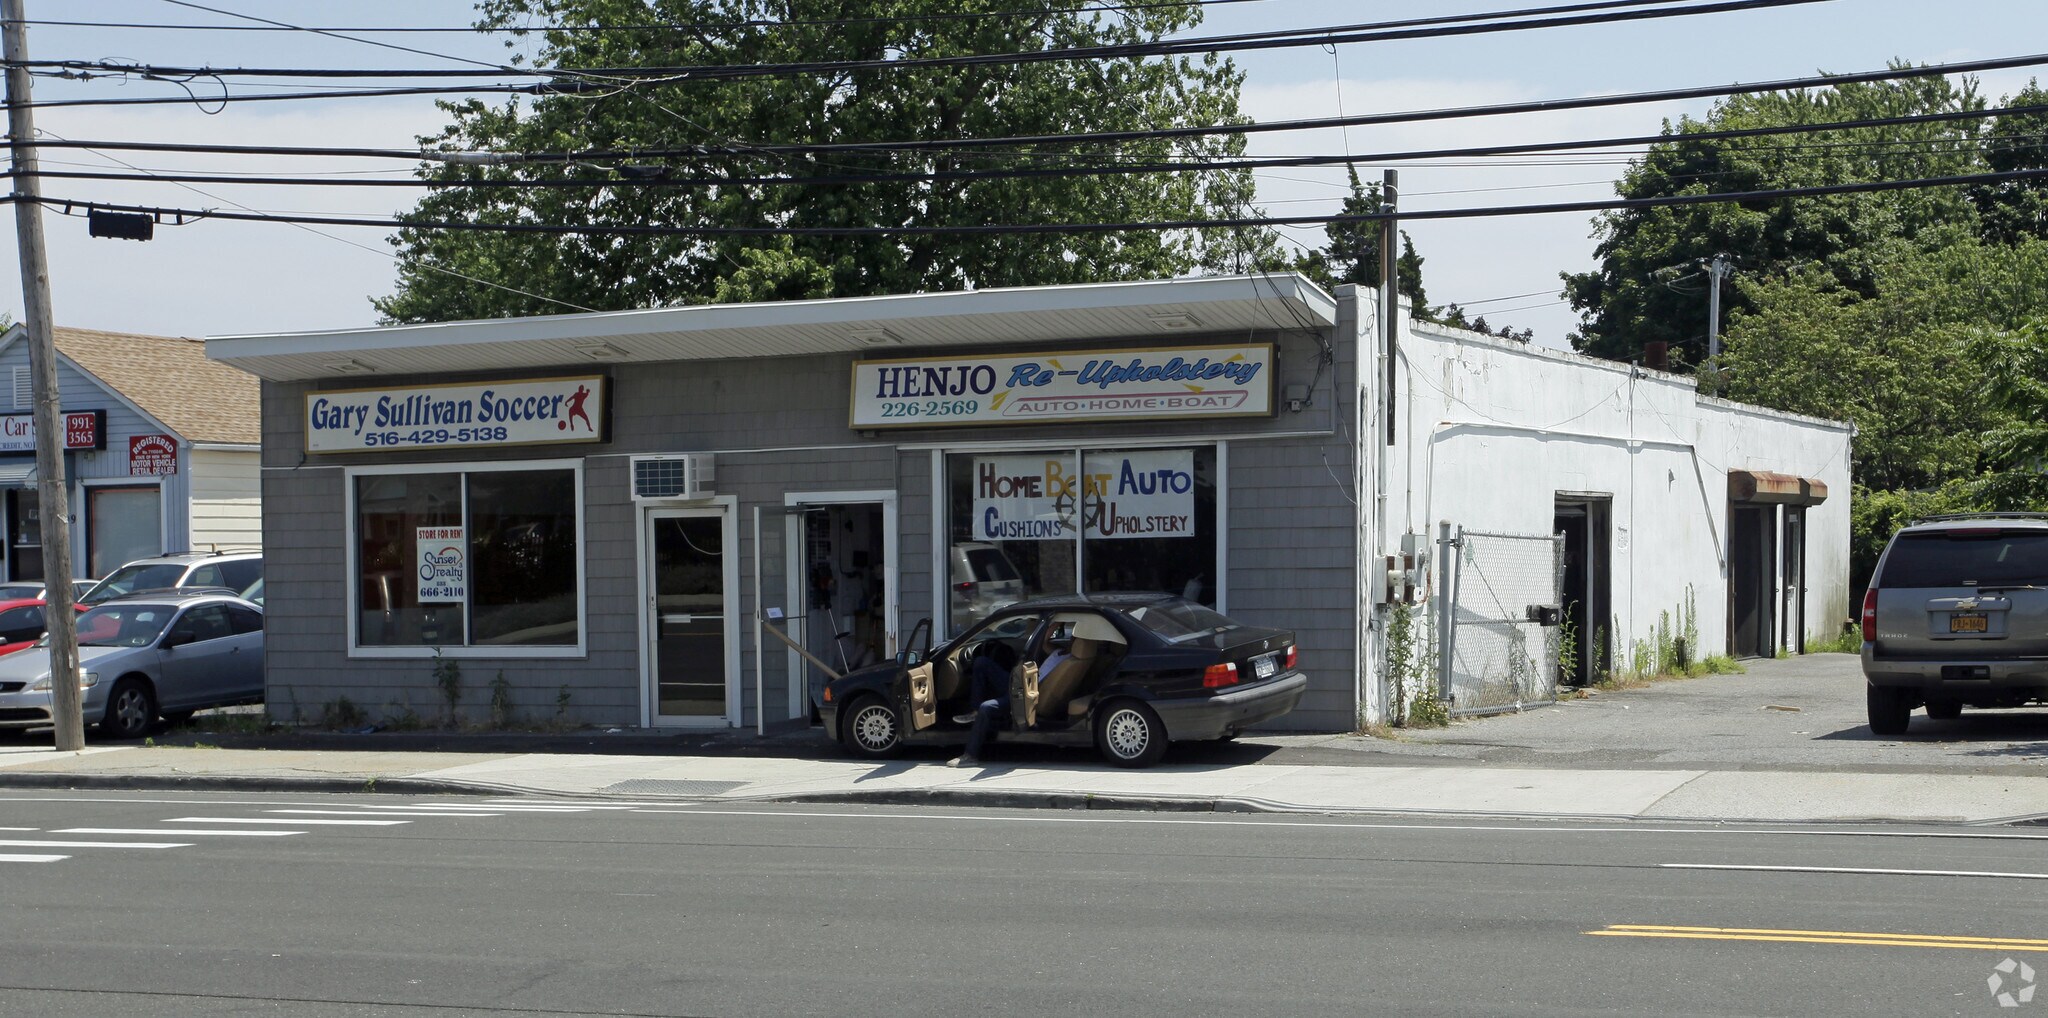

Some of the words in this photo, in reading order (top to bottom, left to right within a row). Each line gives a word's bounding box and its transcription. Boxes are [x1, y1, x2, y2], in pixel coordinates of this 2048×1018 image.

[876, 365, 997, 399] HENJO
[1005, 357, 1263, 389] Re-Upholstery
[312, 398, 370, 436] Gary
[375, 394, 473, 428] Sullivan
[477, 390, 565, 423] Soccer
[881, 400, 979, 418] 226-2569
[1017, 401, 1080, 413] AUTO
[1089, 399, 1157, 410] HOME
[1167, 396, 1232, 408] BOAT
[5, 416, 28, 437] Car
[68, 431, 93, 444] 3565
[365, 426, 508, 446] 516-429-5138
[132, 436, 174, 455] REGISTERED
[131, 460, 152, 468] MOTOR
[152, 458, 176, 467] VEHICLE
[132, 468, 152, 476] RETAIL
[152, 466, 175, 475] DEALER
[979, 462, 1042, 499] HOME
[1118, 459, 1192, 496] AUTO
[984, 506, 1062, 539] CUSHIONS
[1101, 502, 1188, 537] UPHOLSTERY
[419, 530, 436, 539] STORE
[438, 529, 449, 539] FOR
[420, 552, 457, 581] Sunset
[436, 567, 463, 581] realty
[420, 587, 464, 597] 666-2110
